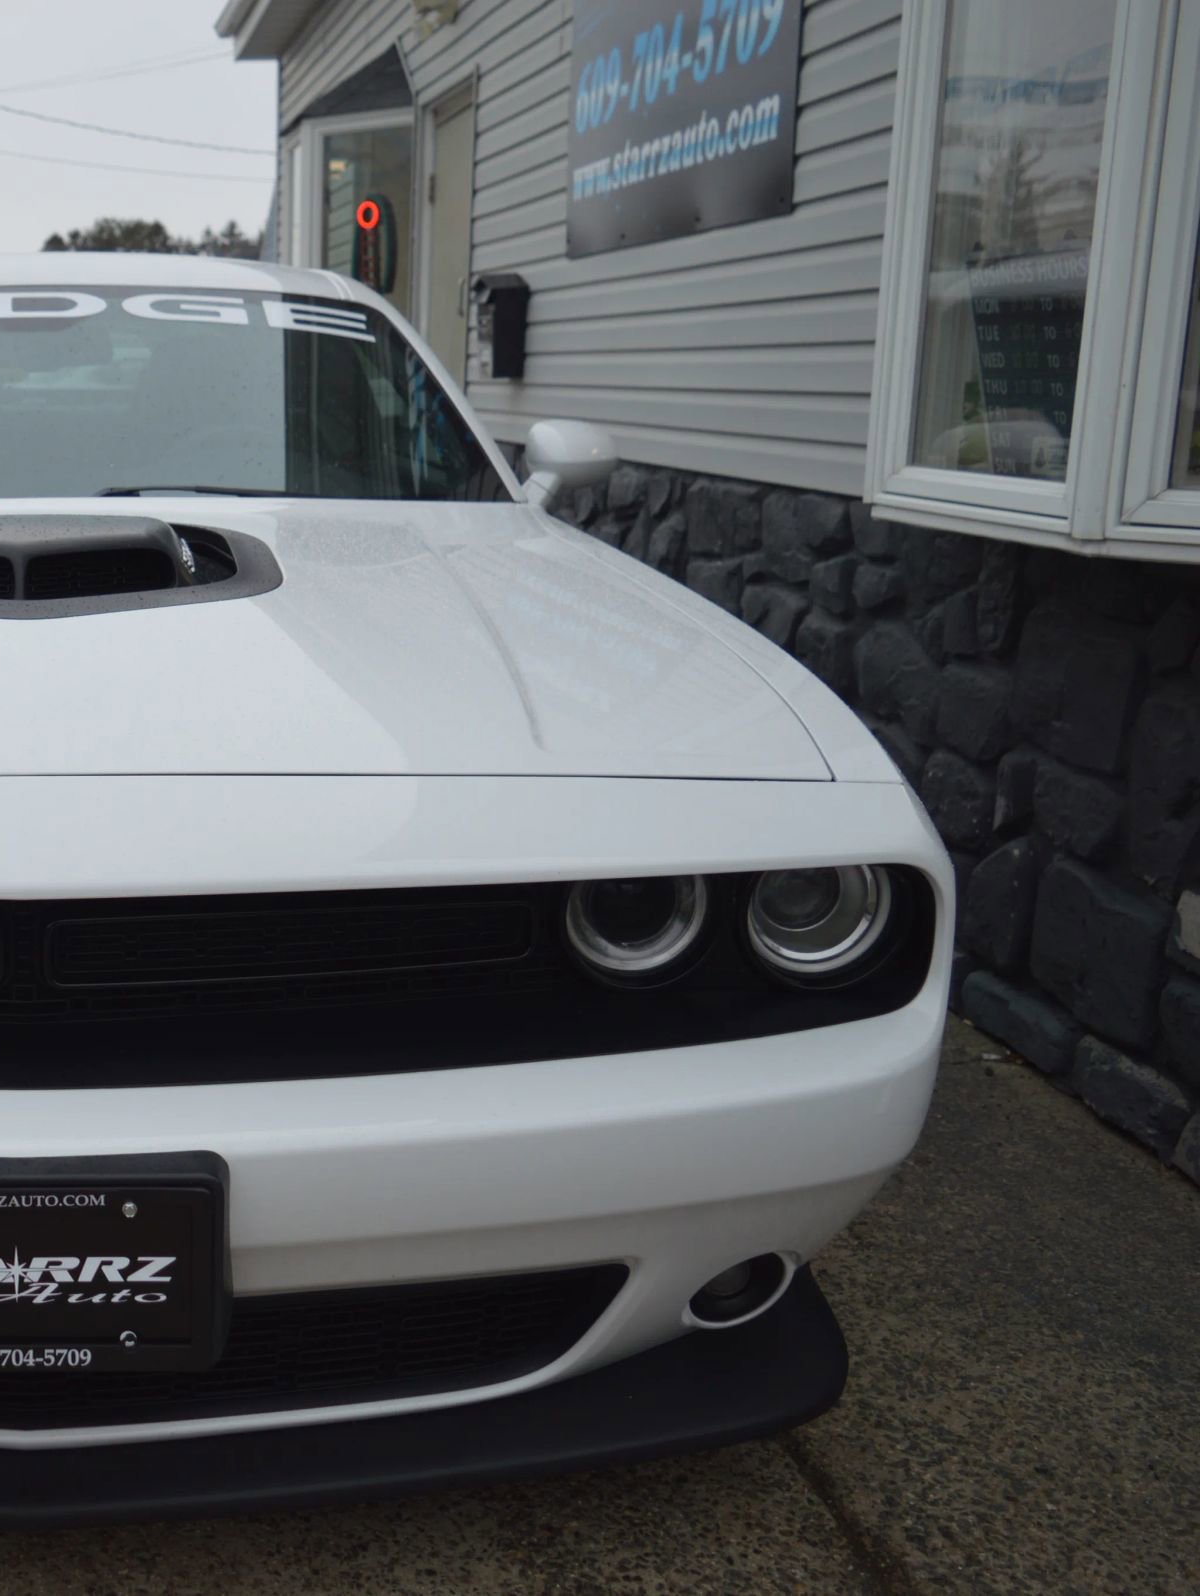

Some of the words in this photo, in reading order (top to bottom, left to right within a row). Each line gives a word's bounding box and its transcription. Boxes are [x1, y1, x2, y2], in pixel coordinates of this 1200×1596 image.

[576, 0, 784, 135] 609-704-5709
[573, 93, 781, 201] www.starrzauto.com
[972, 265, 1033, 287] BUSINESS
[1039, 256, 1088, 280] HOURS
[977, 325, 1001, 341] TUE
[984, 379, 1008, 395] THU
